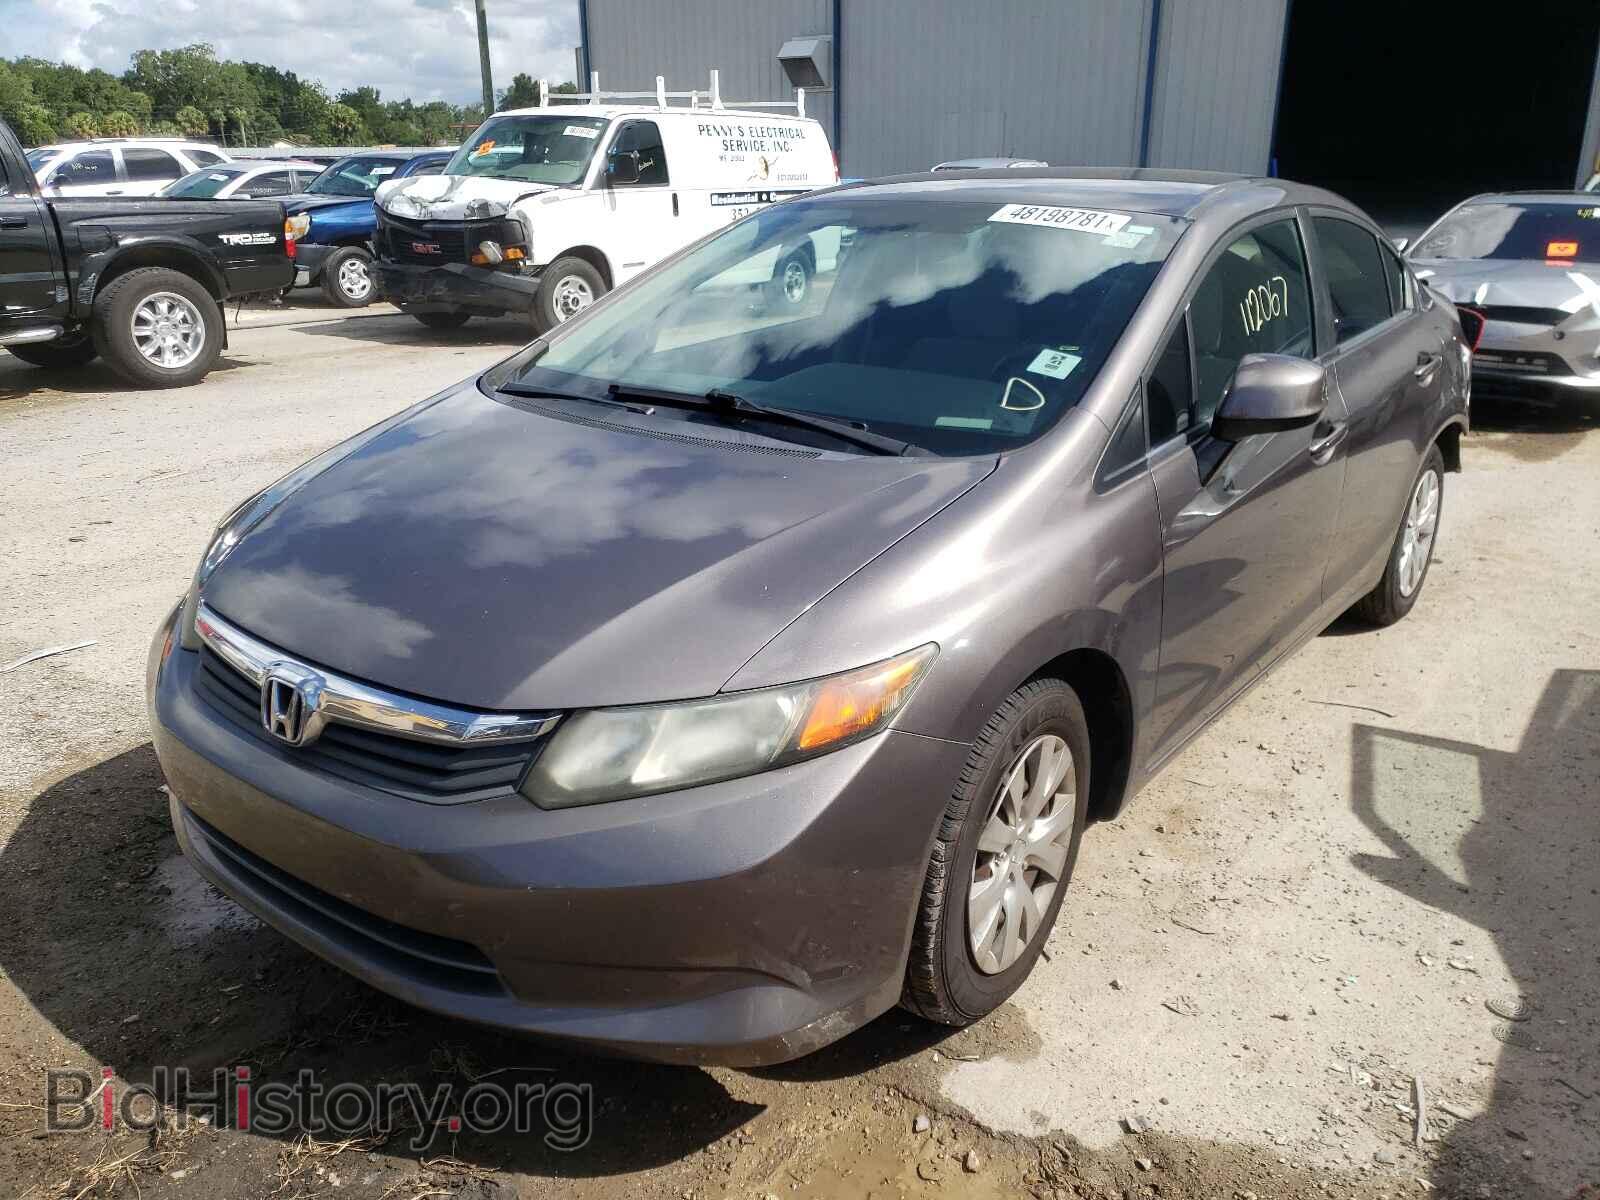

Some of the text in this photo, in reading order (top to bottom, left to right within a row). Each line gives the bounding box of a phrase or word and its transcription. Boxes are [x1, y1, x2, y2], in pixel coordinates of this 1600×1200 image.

[698, 124, 806, 139] PENNY'S ELECTRICAL
[774, 141, 793, 152] INC.
[712, 191, 758, 204] Residential
[1010, 206, 1109, 228] 48198781
[218, 233, 253, 245] TRD
[412, 242, 442, 254] GMC
[1240, 276, 1288, 336] 112067
